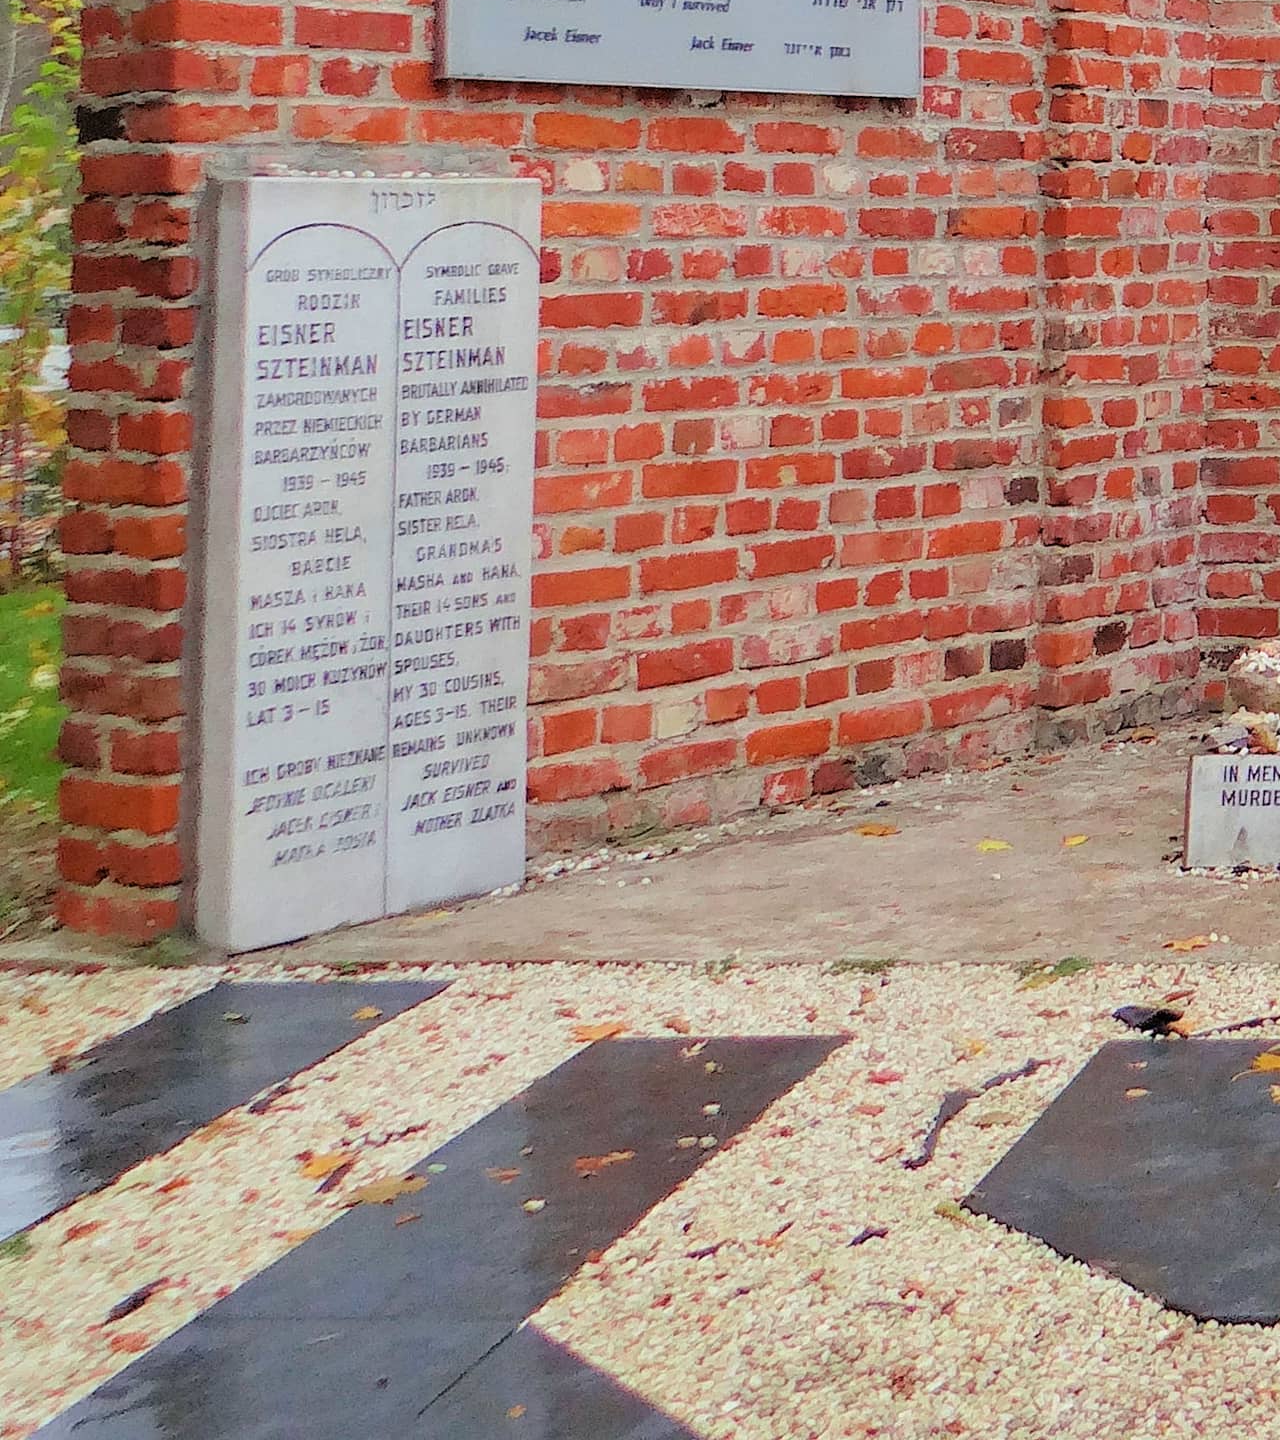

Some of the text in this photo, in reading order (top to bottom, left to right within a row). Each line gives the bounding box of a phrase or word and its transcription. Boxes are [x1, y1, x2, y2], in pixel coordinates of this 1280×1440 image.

[885, 0, 904, 14] רק
[689, 36, 715, 51] Jack
[426, 262, 520, 279] SYMBOLIC GRAVE
[434, 287, 508, 306] FAMILIES
[257, 322, 336, 346] EISNER
[404, 316, 475, 340] EISNER
[255, 354, 378, 380] SZTEINMAN
[402, 346, 506, 373] SZTEINMAN
[257, 387, 378, 410] ZAMORDOWANYCH
[401, 376, 529, 400] BRUTALLY ANNIHILATED
[255, 419, 298, 436] PRZEZ
[401, 406, 483, 427] BY GERMAN
[400, 431, 489, 455] BARBARIANS
[283, 470, 367, 492] 1939 1945
[427, 462, 456, 480] 1939
[398, 490, 442, 509] FATHER
[253, 503, 300, 522] OJCIEC
[397, 517, 442, 537] SISTER
[250, 530, 316, 552] SIOSTRA
[291, 555, 352, 577] BABCIE
[396, 572, 474, 593] MASHA AND
[250, 588, 306, 611] MASZA
[396, 600, 431, 620] THEIR
[455, 592, 489, 611] SONS
[495, 592, 516, 605] AND
[249, 622, 274, 640] ICH
[394, 615, 521, 648] DAUGHTERS WITH
[247, 673, 316, 698] 30 MOICH
[394, 685, 413, 702] MY
[418, 681, 437, 699] 30
[246, 707, 277, 728] LAT
[393, 695, 518, 731] AGES THEIR
[392, 722, 517, 758] REMAINS UNKNOWN
[423, 753, 491, 780] SURVIVED
[1223, 764, 1238, 782] IN
[401, 778, 518, 812] JACK EISNER AND
[412, 801, 516, 837] MOTHER ZLATKA
